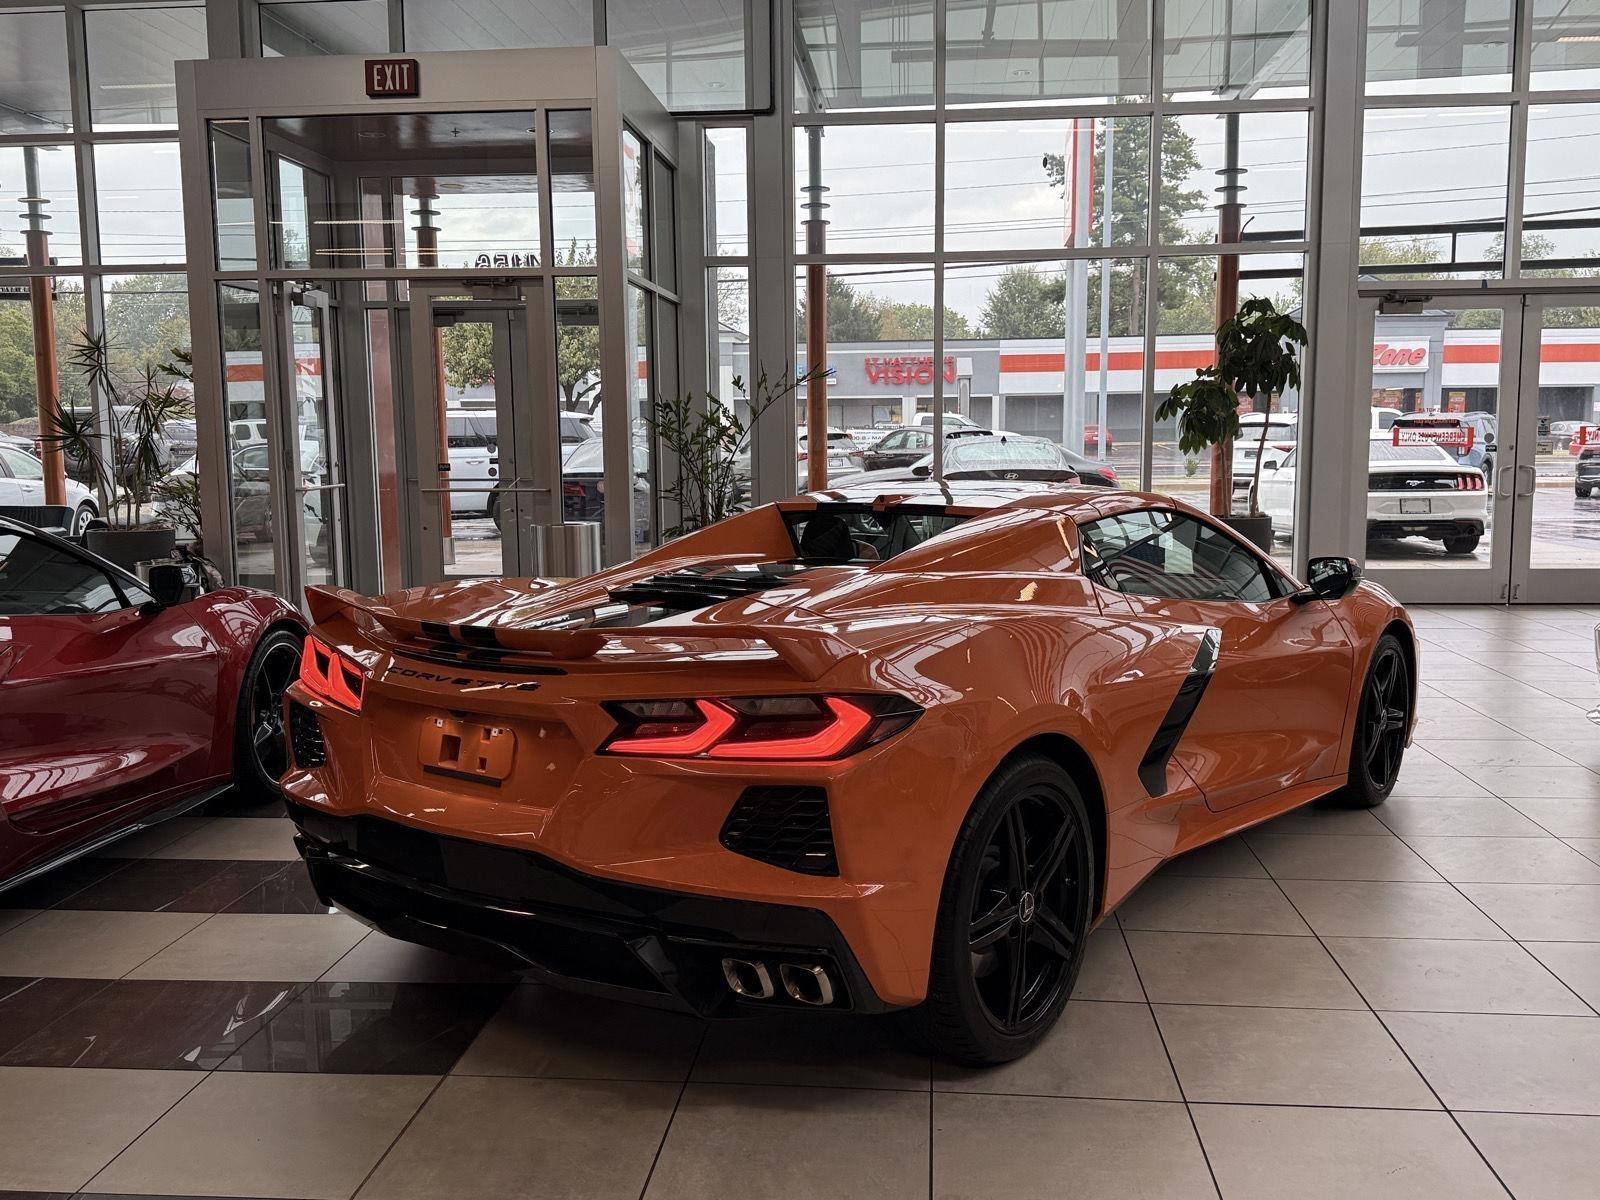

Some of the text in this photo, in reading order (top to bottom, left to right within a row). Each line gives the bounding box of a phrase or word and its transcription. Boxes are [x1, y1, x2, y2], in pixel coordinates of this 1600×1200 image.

[373, 64, 410, 91] EXIT
[883, 355, 955, 367] MATTHES
[865, 365, 957, 385] VISION
[388, 666, 541, 691] CORVETTE
